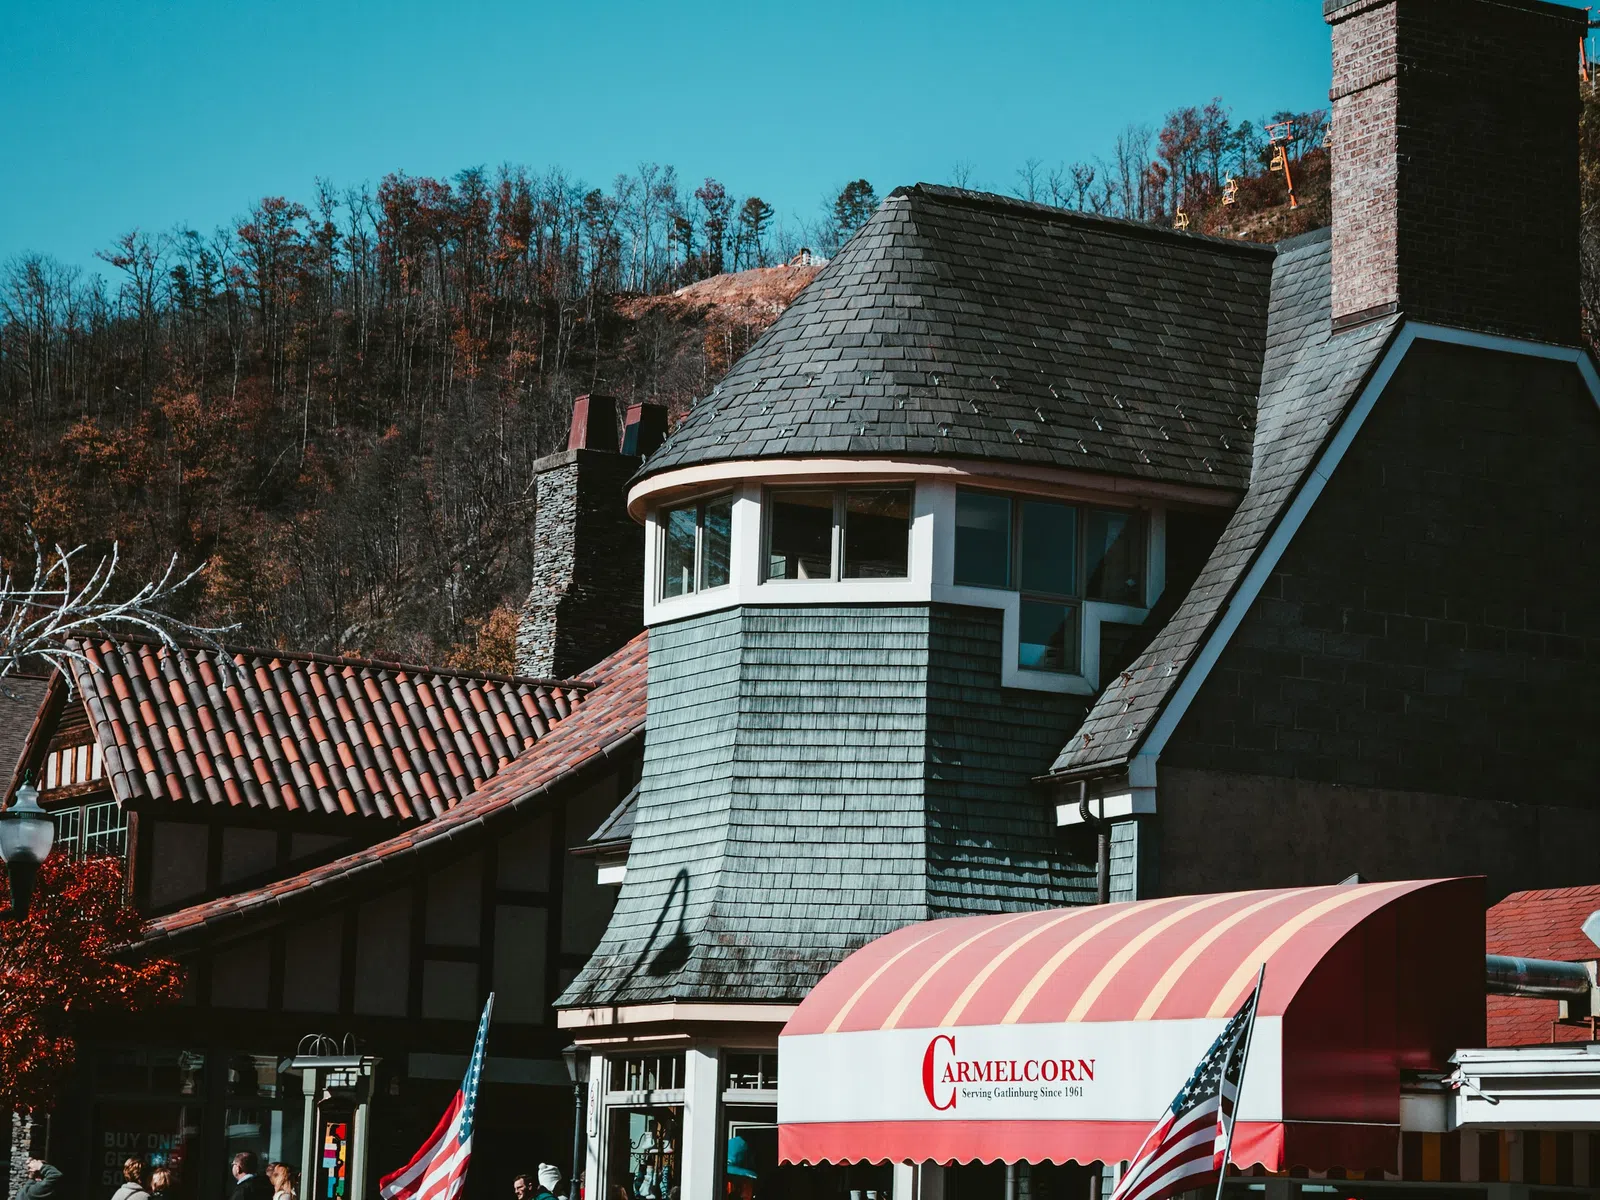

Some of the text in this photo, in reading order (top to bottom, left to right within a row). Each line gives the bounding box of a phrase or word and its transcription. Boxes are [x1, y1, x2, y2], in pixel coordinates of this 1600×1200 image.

[922, 1034, 1096, 1111] CARMELCORN
[962, 1086, 1083, 1101] Serving Gatlinburg Since 1961
[104, 1131, 181, 1150] BUY ONE
